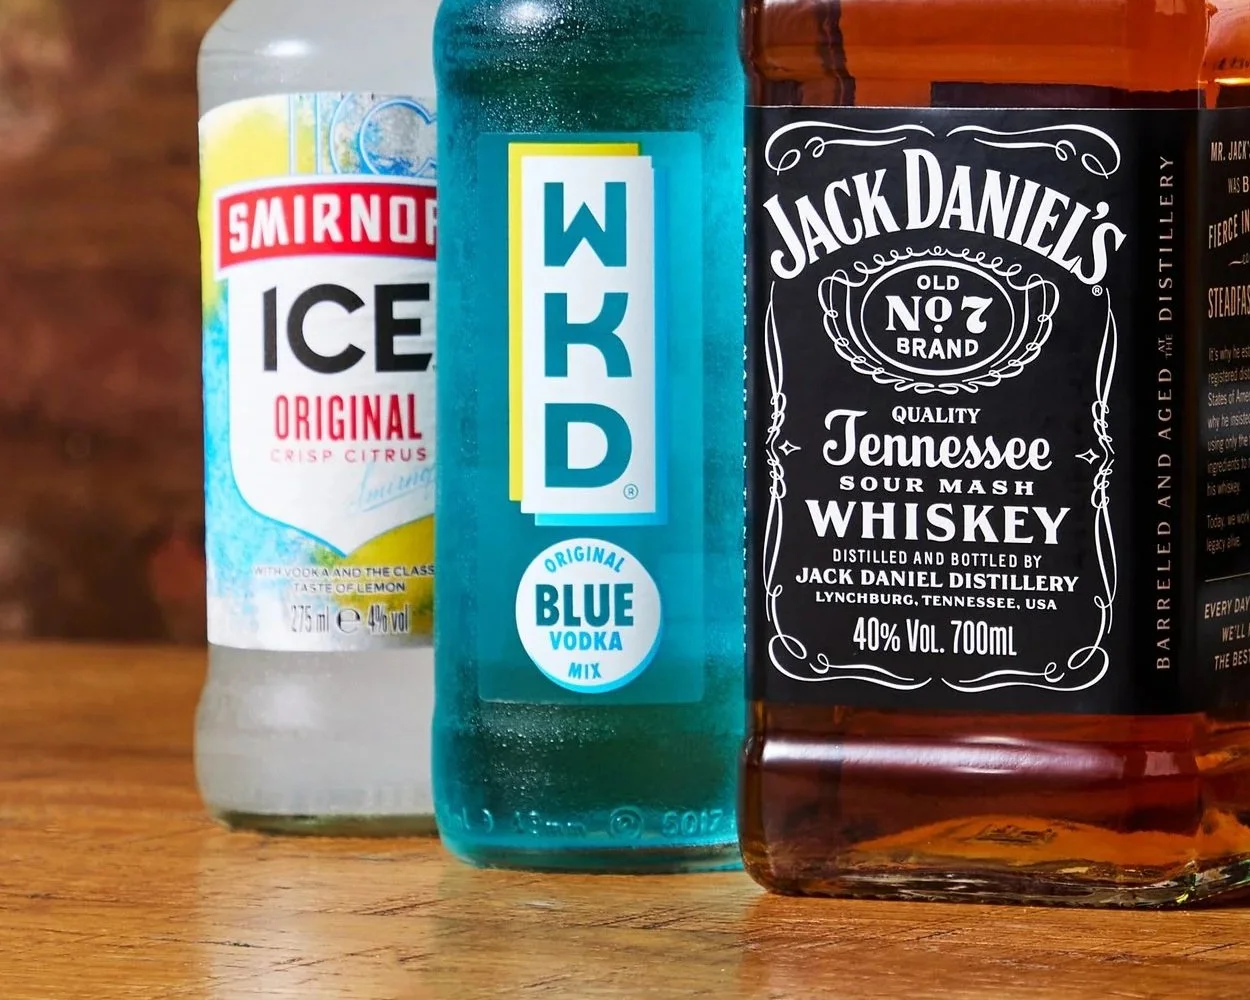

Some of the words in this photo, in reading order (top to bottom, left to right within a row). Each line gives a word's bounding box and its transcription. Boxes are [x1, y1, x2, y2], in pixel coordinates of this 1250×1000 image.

[1211, 141, 1226, 162] MR.
[1228, 177, 1240, 193] WAS
[229, 194, 437, 253] SMIRNOF
[763, 168, 901, 280] JACK
[902, 148, 1127, 285] DANIEL'S
[1158, 156, 1174, 321] DISTILLERY
[1208, 214, 1238, 249] FIERCE
[917, 275, 959, 291] OLD
[263, 283, 432, 374] ICE
[544, 182, 632, 487] WKD
[896, 338, 979, 360] BRAND
[1157, 337, 1165, 353] AT
[891, 405, 981, 424] QUALITY
[1158, 368, 1173, 440] AGED
[274, 394, 422, 440] ORIGINAL
[822, 408, 1053, 472] Tennessee
[270, 448, 331, 463] CRISP
[344, 447, 427, 463] CITRUS
[839, 475, 924, 494] SOUR
[939, 478, 1035, 497] MASH
[1157, 453, 1172, 508] AND
[804, 499, 1071, 546] WHISKEY
[544, 546, 625, 573] ORIGINAL
[832, 548, 907, 566] DISTILLED
[912, 550, 945, 567] AND
[951, 552, 1017, 569] BOTTLED
[1023, 554, 1042, 569] BY
[254, 567, 281, 577] WITH
[285, 567, 330, 578] VODKA
[332, 567, 361, 578] AND
[366, 567, 389, 577] THE
[393, 565, 435, 577] CLASS
[795, 567, 853, 586] JACK
[860, 568, 943, 589] DANIEL
[949, 572, 1079, 592] DISTILLERY
[293, 583, 332, 594] TASTE
[336, 583, 354, 593] OF
[357, 582, 405, 593] LEMON
[1156, 521, 1171, 670] BARRELED
[535, 584, 634, 627] BLUE
[815, 591, 919, 607] LYNCHBURG,
[921, 595, 1020, 610] TENNESSEE,
[1026, 598, 1057, 611] USA
[1204, 599, 1233, 619] EVERY
[1234, 595, 1250, 614] DAY
[368, 604, 388, 632] 4%
[392, 605, 409, 632] vol
[550, 631, 623, 651] VODKA
[852, 616, 901, 652] 40%
[1222, 623, 1246, 642] WE'LL
[1214, 653, 1230, 671] THE
